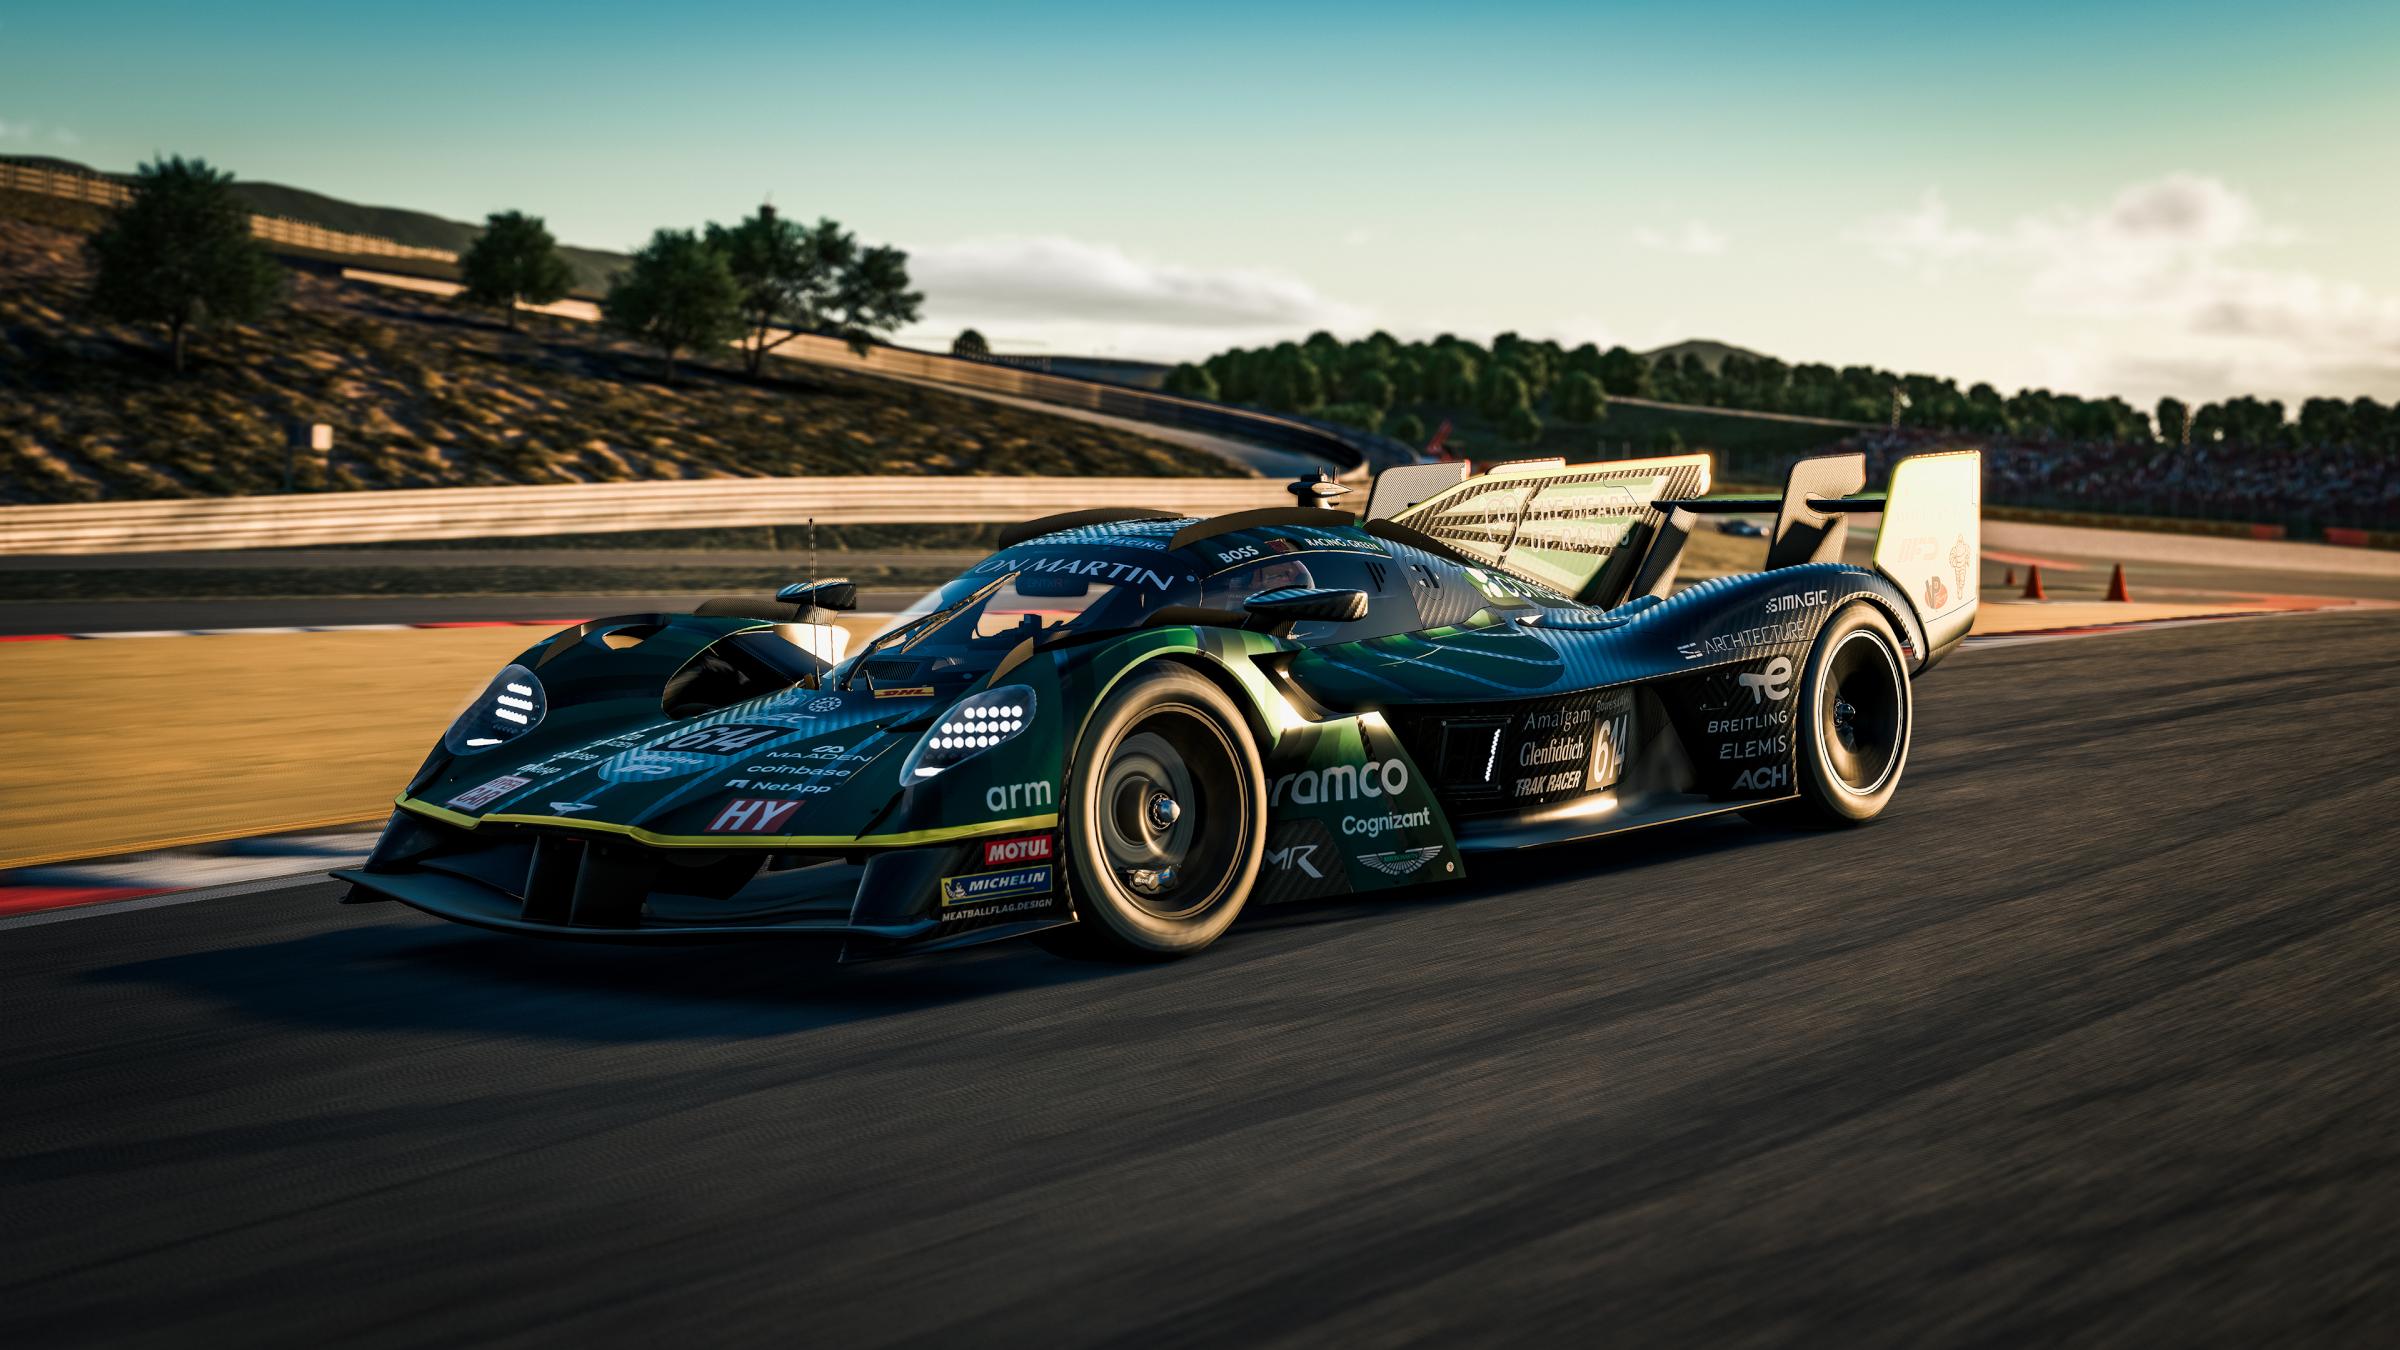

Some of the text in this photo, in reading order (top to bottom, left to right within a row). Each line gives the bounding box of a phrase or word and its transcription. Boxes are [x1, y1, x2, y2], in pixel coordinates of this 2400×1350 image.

[1561, 523, 1630, 551] RACING
[1218, 545, 1260, 564] BOSS
[1024, 558, 1175, 591] MARTIN
[1765, 589, 1828, 614] SIMAGIC
[1704, 620, 1808, 655] ARCHITECTURE
[1524, 705, 1591, 732] Amalgam
[1707, 710, 1788, 733] BREITLING
[667, 726, 777, 752] 614
[1519, 735, 1585, 767] Glenfiddich
[1593, 714, 1628, 783] 614
[1719, 735, 1787, 760] ELEMIS
[765, 751, 873, 763] MAADEN
[746, 765, 852, 778] coinbase
[1514, 769, 1582, 797] TRAK RACER
[1731, 763, 1787, 790] ACH
[751, 781, 832, 795] NetApp
[986, 780, 1053, 812] arm
[710, 800, 799, 831] HY
[1341, 807, 1431, 839] Cognizant
[988, 838, 1050, 863] MOTUL
[968, 871, 1047, 893] MICHELIN
[942, 898, 1053, 922] MEATBALLFLAG.DESIGN
